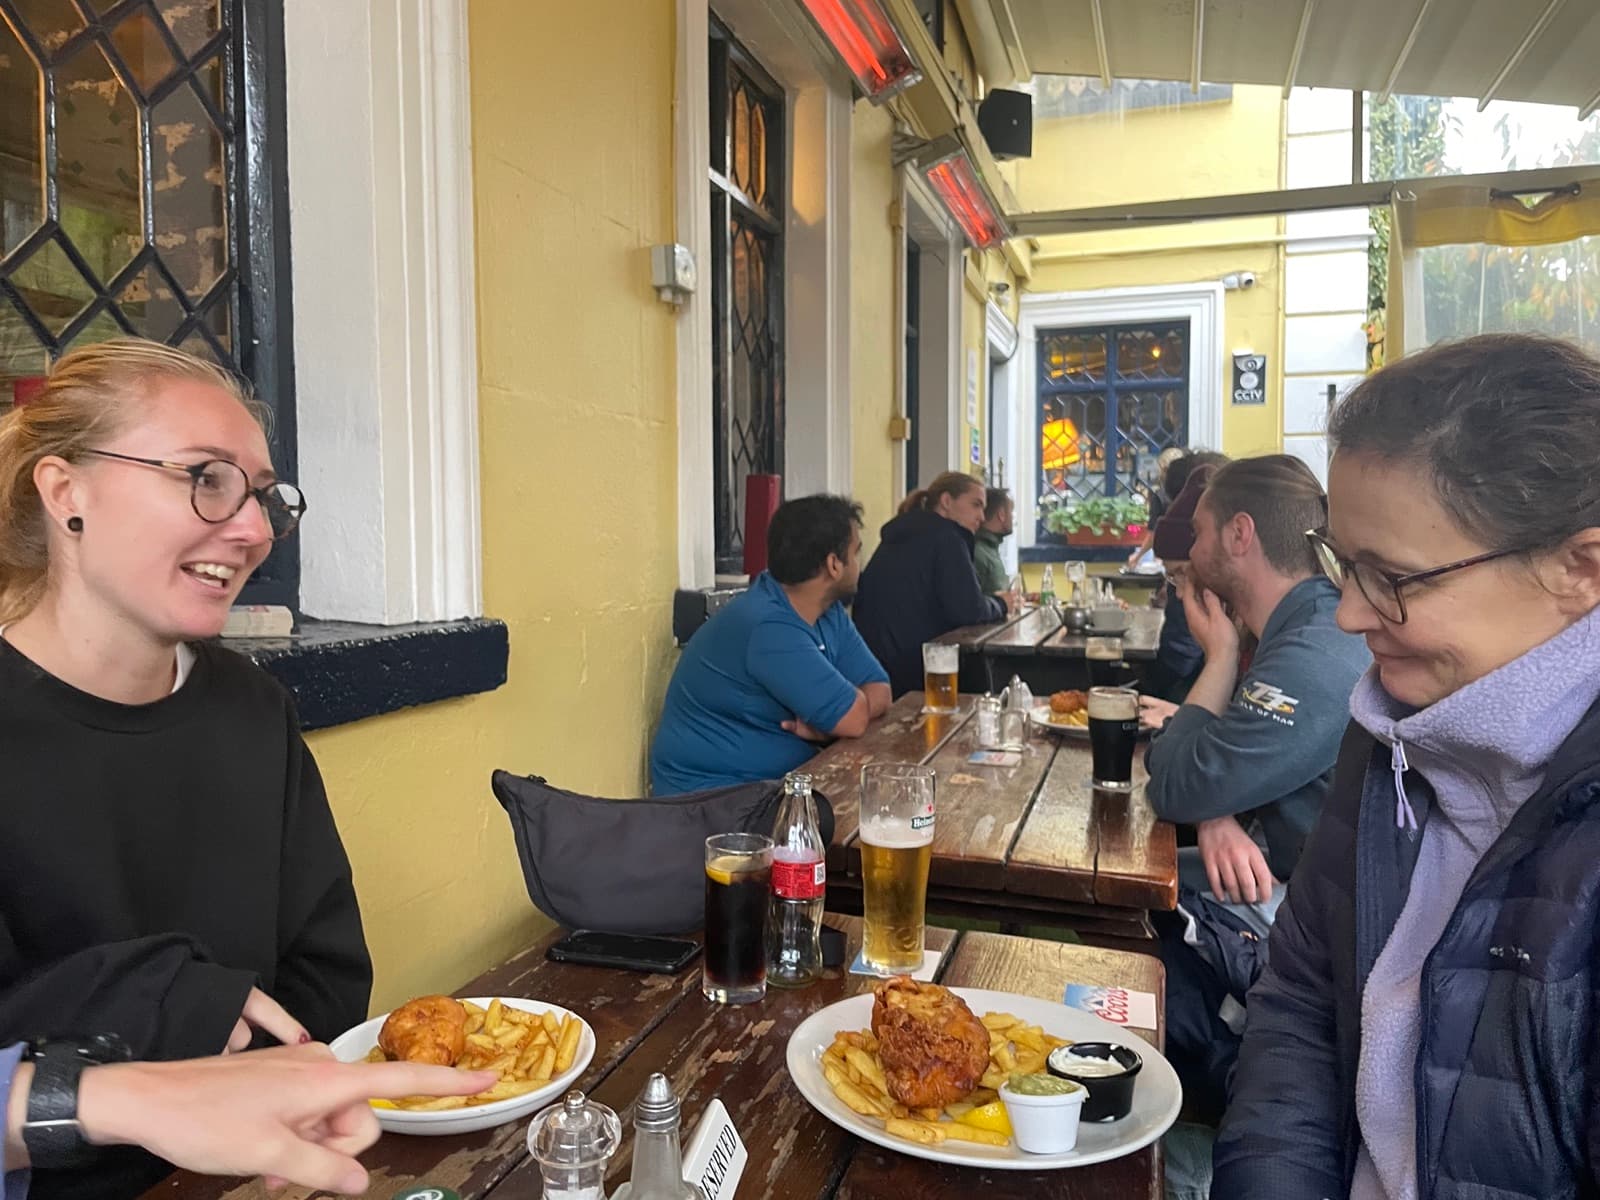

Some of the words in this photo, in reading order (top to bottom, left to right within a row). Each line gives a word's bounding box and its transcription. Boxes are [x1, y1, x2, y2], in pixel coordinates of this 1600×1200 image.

[1234, 388, 1263, 401] CCTV
[1256, 707, 1269, 717] OF
[1272, 713, 1294, 727] MAN
[1095, 986, 1129, 1024] Coors
